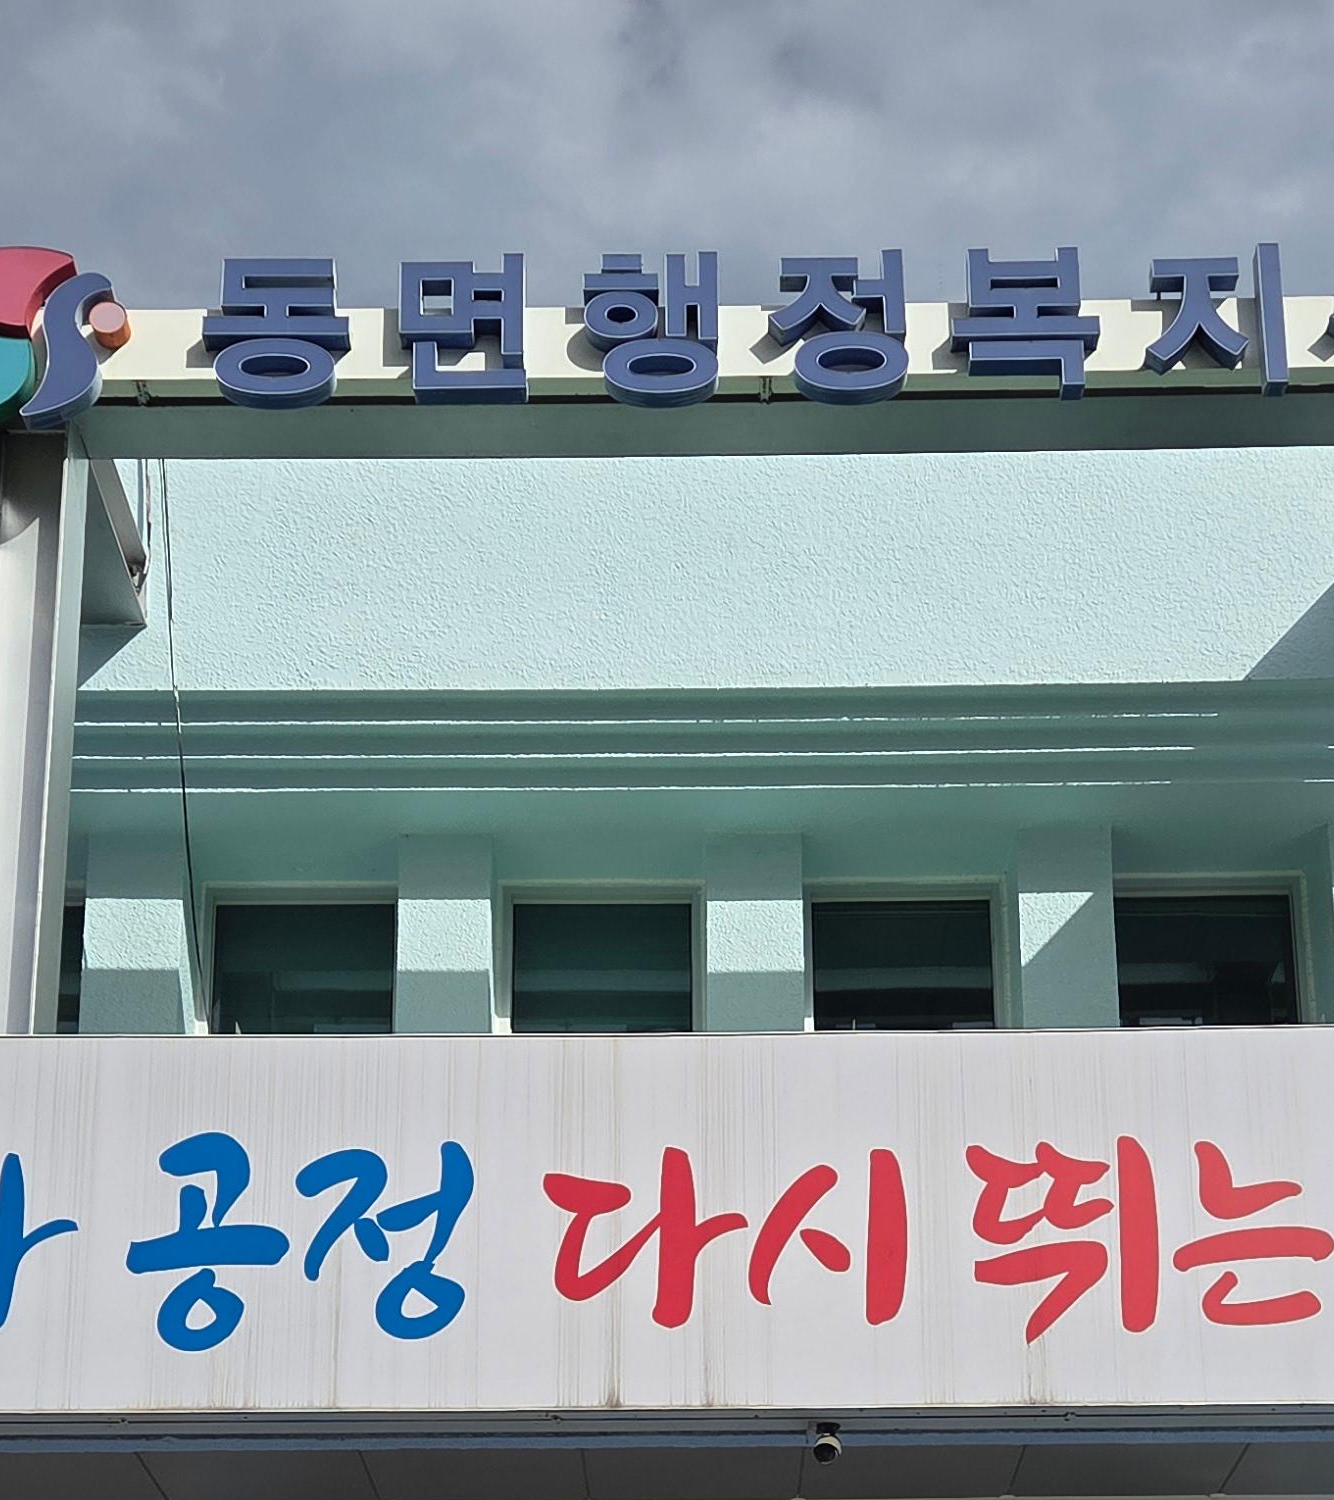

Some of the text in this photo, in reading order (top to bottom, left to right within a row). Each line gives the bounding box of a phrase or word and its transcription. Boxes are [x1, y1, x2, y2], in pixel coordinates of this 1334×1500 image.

[124, 1131, 475, 1352] 공정
[543, 1147, 910, 1330] 다시
[969, 1131, 1334, 1344] 뛰는
